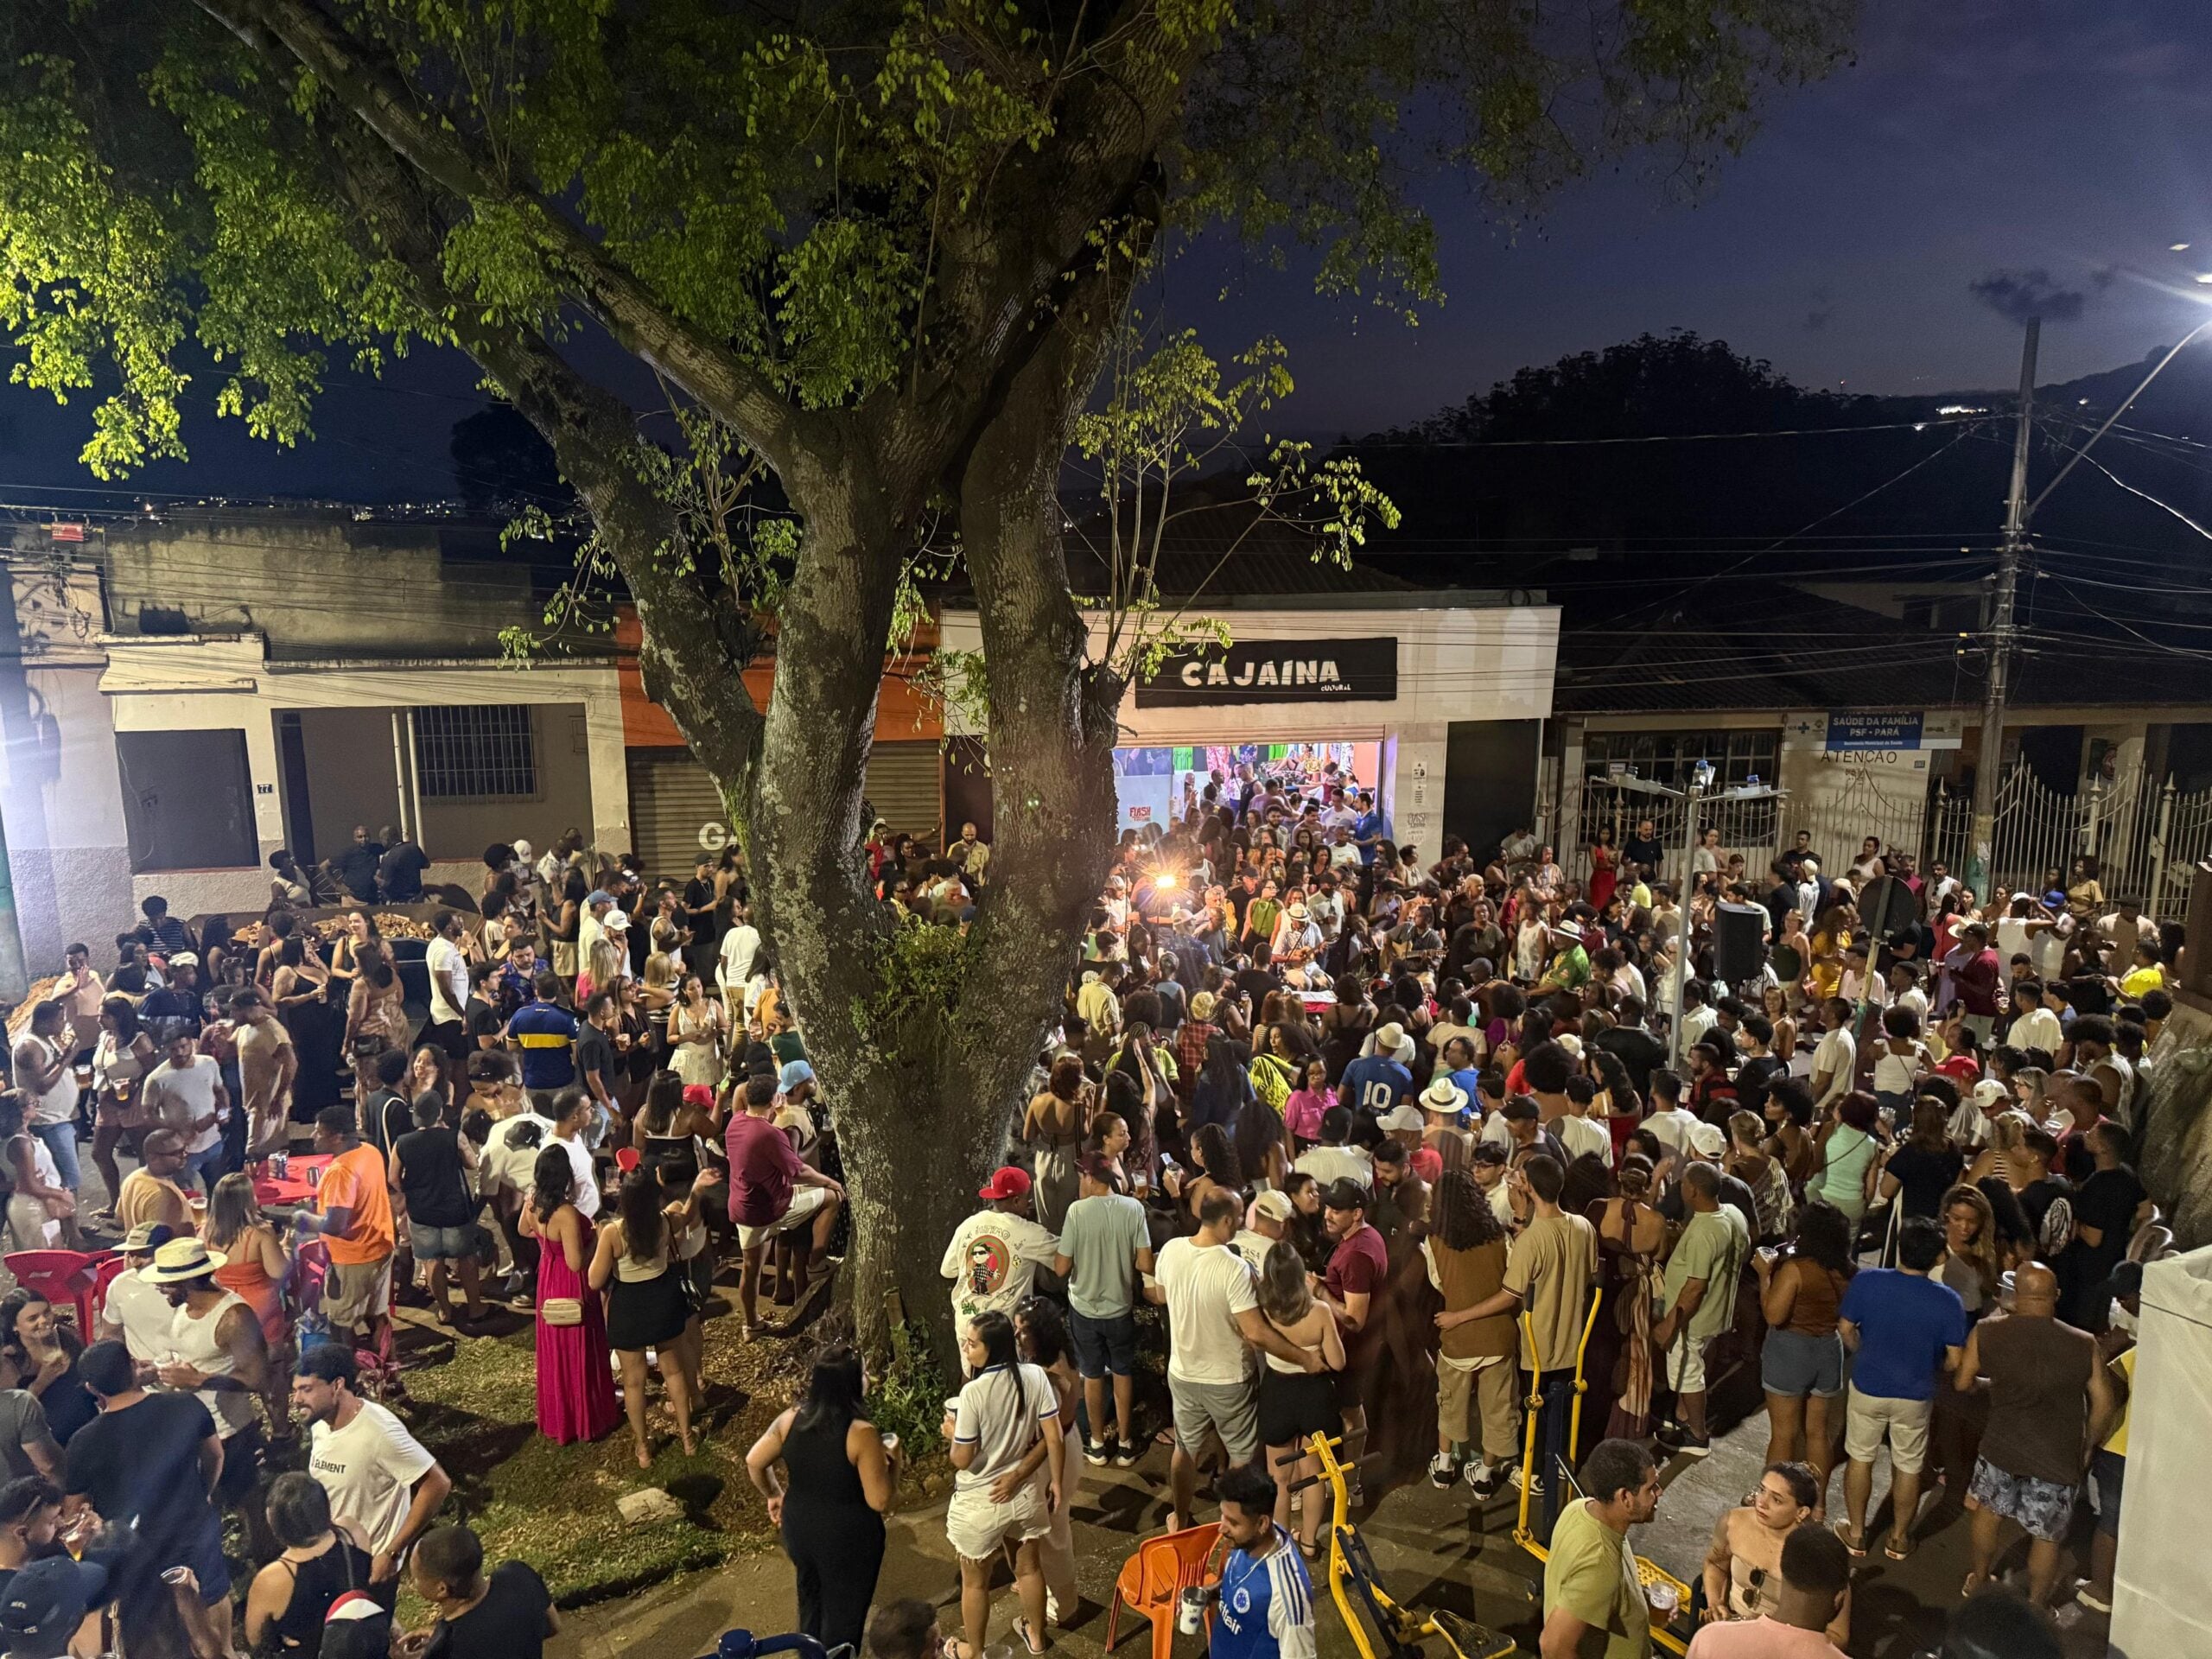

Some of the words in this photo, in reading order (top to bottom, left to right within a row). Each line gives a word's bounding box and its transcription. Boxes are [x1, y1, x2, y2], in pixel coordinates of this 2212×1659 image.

[1833, 715, 1865, 726] SAÚDE
[1866, 717, 1879, 726] DA
[1881, 715, 1919, 726] FAMÍLIA
[1850, 728, 1867, 737] PSF
[1874, 726, 1900, 736] PARÁ
[259, 785, 270, 793] 77
[1363, 1080, 1392, 1109] 10
[315, 1459, 346, 1474] ELEMENT
[1218, 1588, 1243, 1635] etfair
